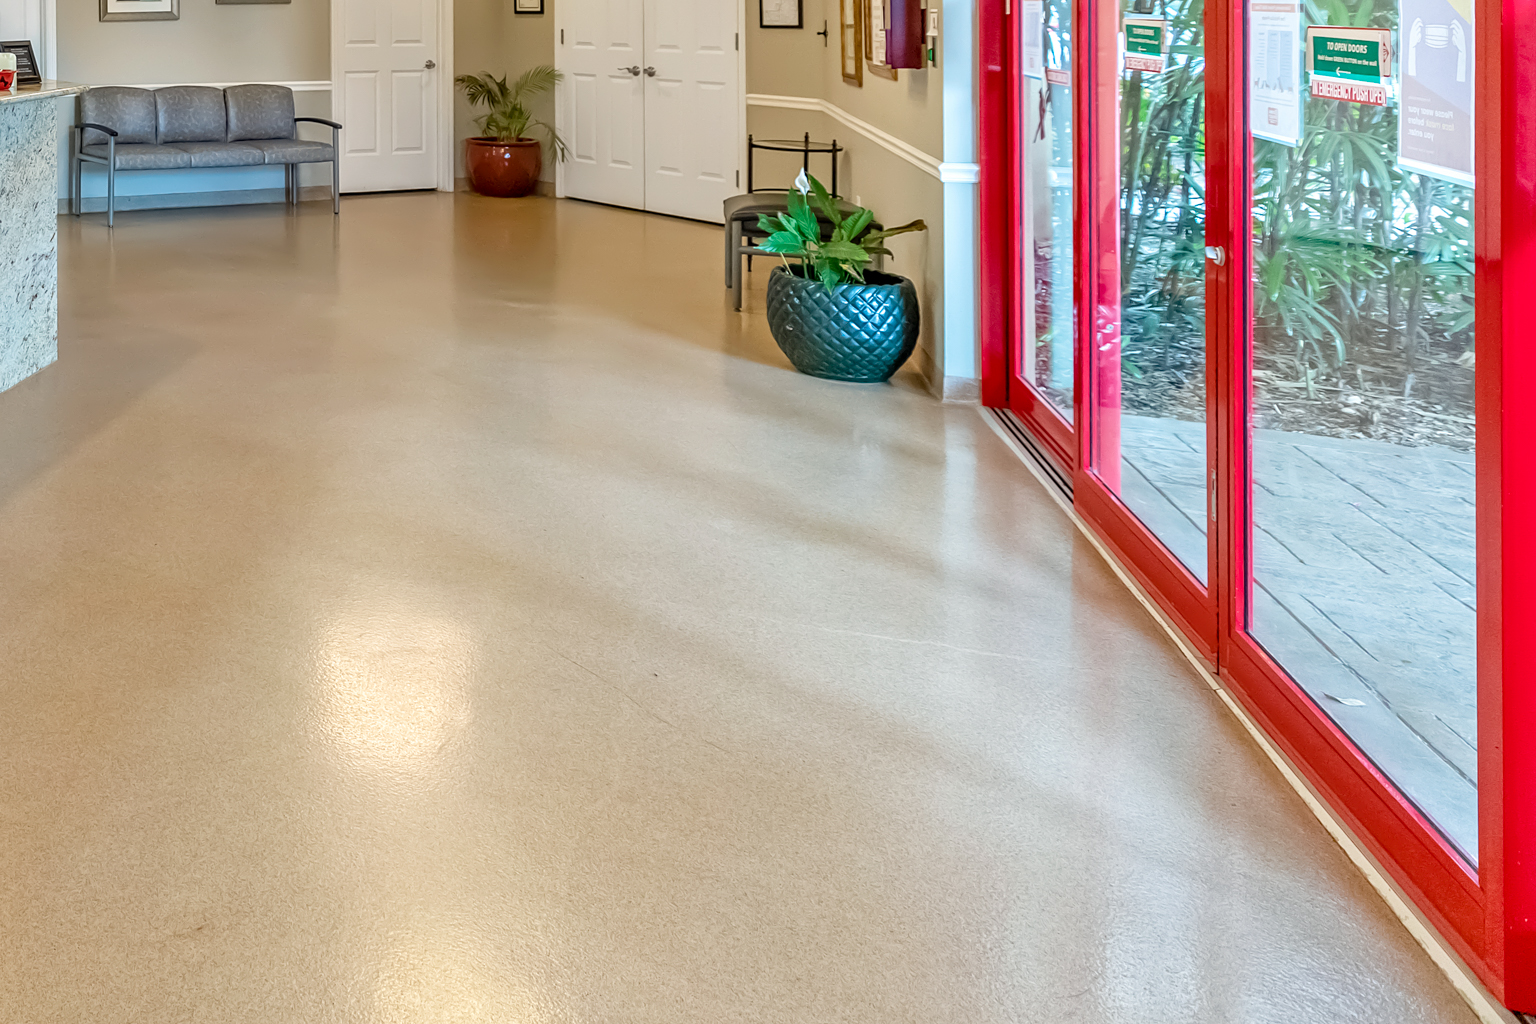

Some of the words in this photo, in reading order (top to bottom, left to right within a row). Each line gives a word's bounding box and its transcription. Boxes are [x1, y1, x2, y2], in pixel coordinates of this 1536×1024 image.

[1327, 42, 1333, 50] TO
[1334, 43, 1347, 52] OPEN
[1348, 44, 1368, 54] DOORS
[1319, 82, 1351, 100] EMERGENCY
[1352, 87, 1368, 102] PUSH
[1369, 90, 1386, 104] OPEN
